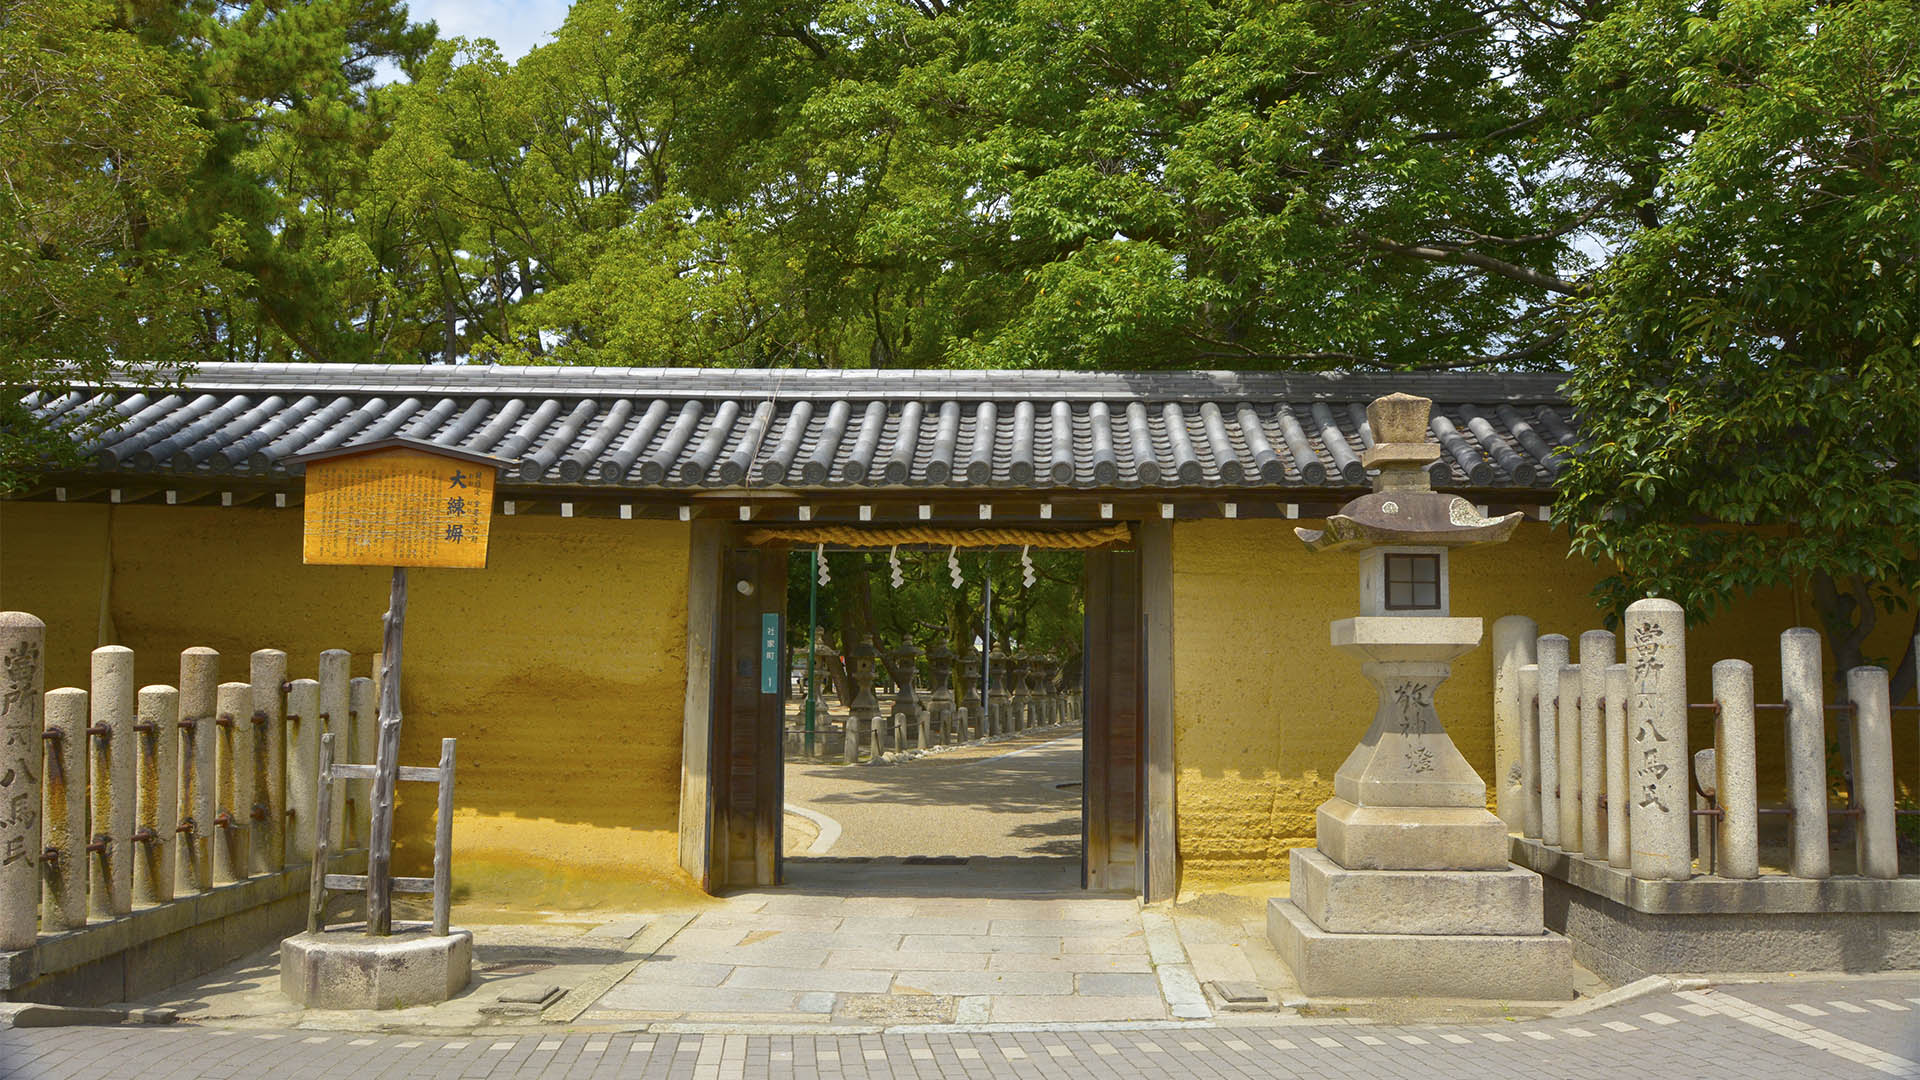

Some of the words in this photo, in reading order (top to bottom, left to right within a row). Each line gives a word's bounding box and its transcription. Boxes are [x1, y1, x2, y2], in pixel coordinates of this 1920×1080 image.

[446, 468, 467, 545] 大練塀
[765, 626, 776, 661] 社家町
